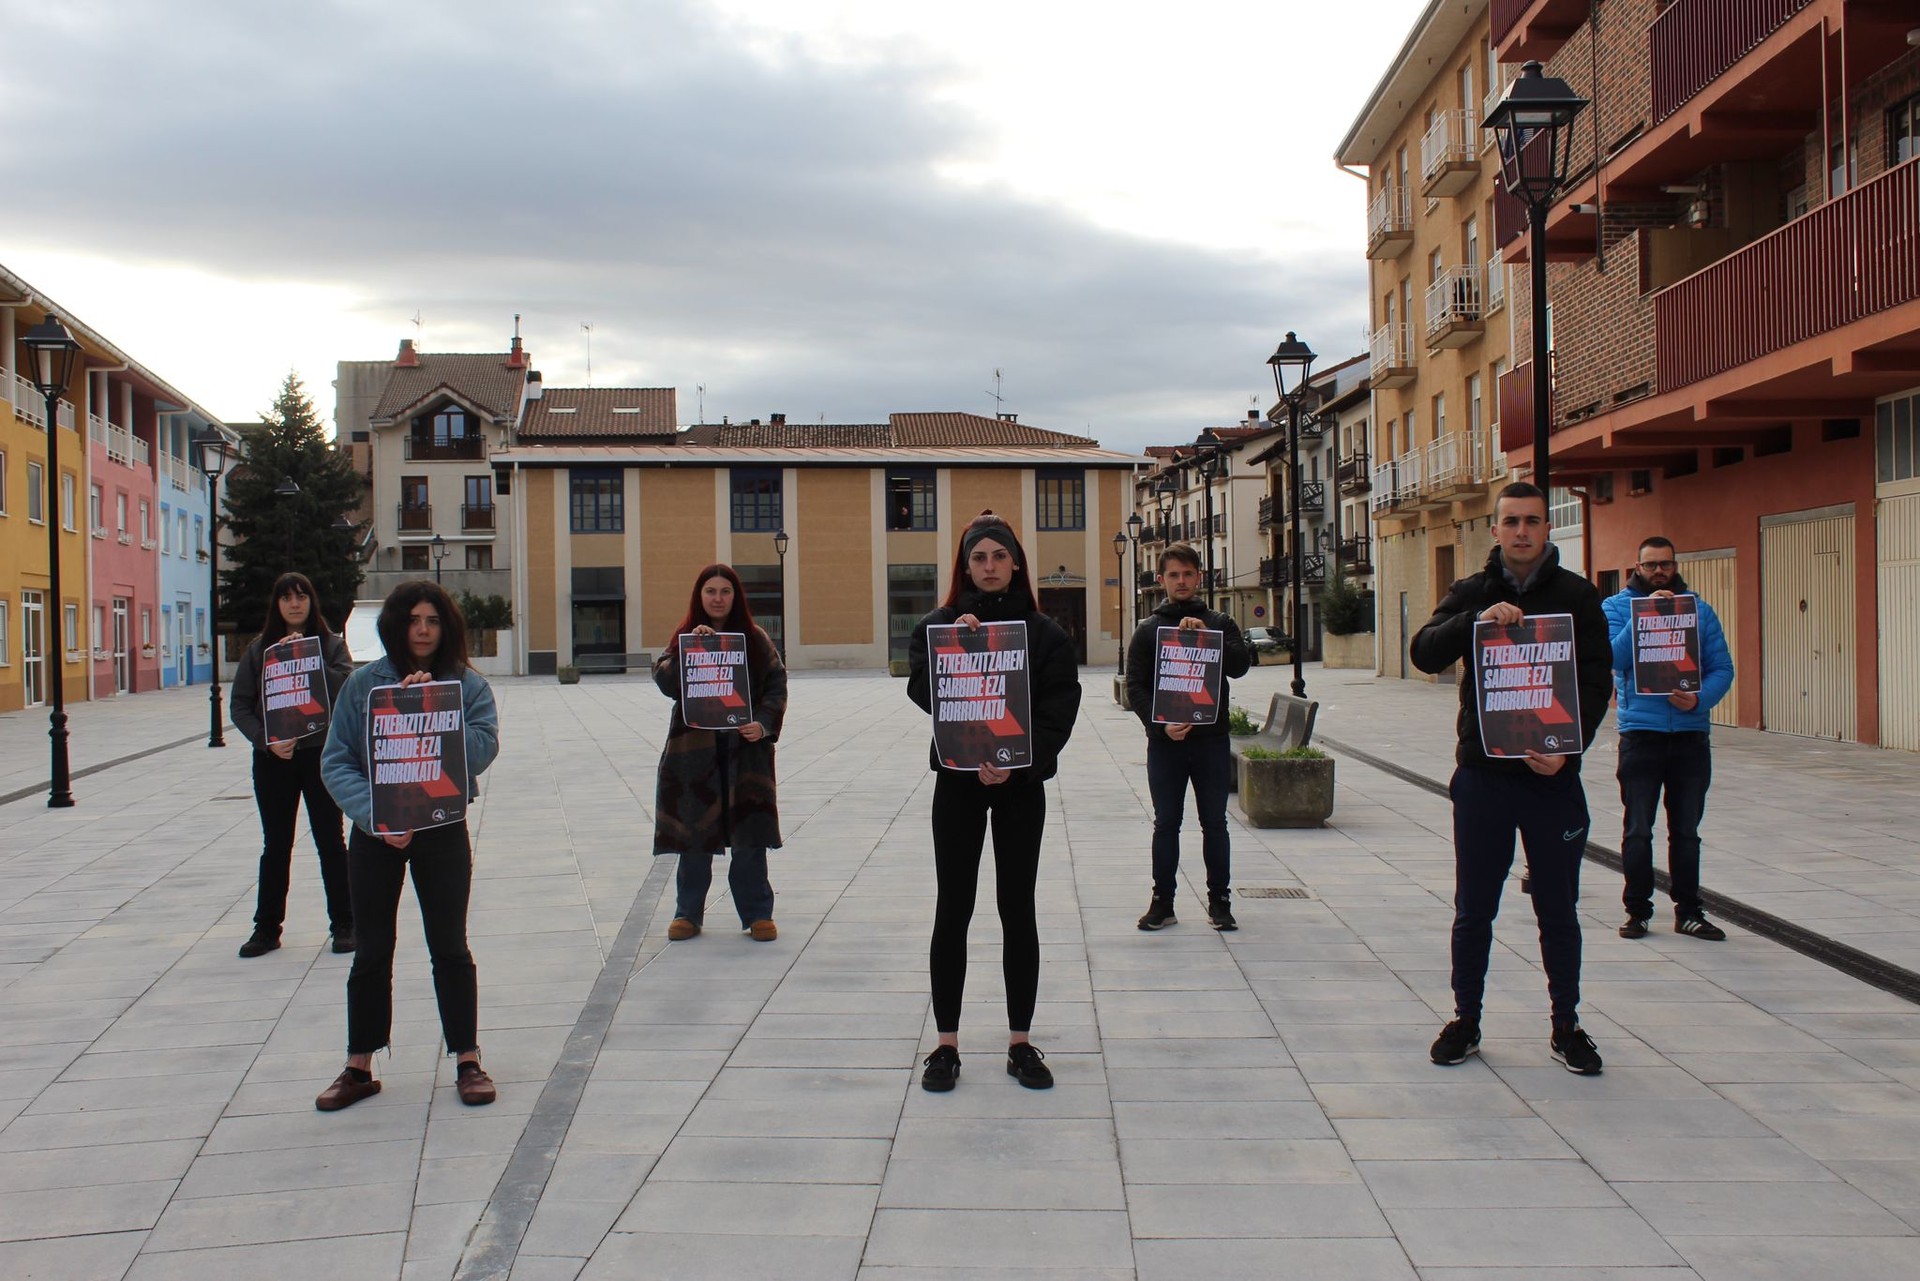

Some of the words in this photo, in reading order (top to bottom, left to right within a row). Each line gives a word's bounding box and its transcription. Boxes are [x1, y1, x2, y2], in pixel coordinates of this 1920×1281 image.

[936, 649, 1025, 674] ETXEBIZITZAREN
[1482, 641, 1572, 666] ETXEBIZITZAREN
[937, 676, 985, 698] SARBIDE
[985, 674, 1006, 697] EZA
[1484, 666, 1532, 689] SARBIDE
[1532, 665, 1553, 686] EZA
[938, 699, 1006, 722] BORROKATU
[1485, 688, 1553, 712] BORROKATU
[373, 710, 461, 736] ETXEBIZITZAREN
[374, 737, 421, 761] SARBIDE
[421, 736, 441, 758] EZA
[375, 760, 442, 785] BORROKATU
